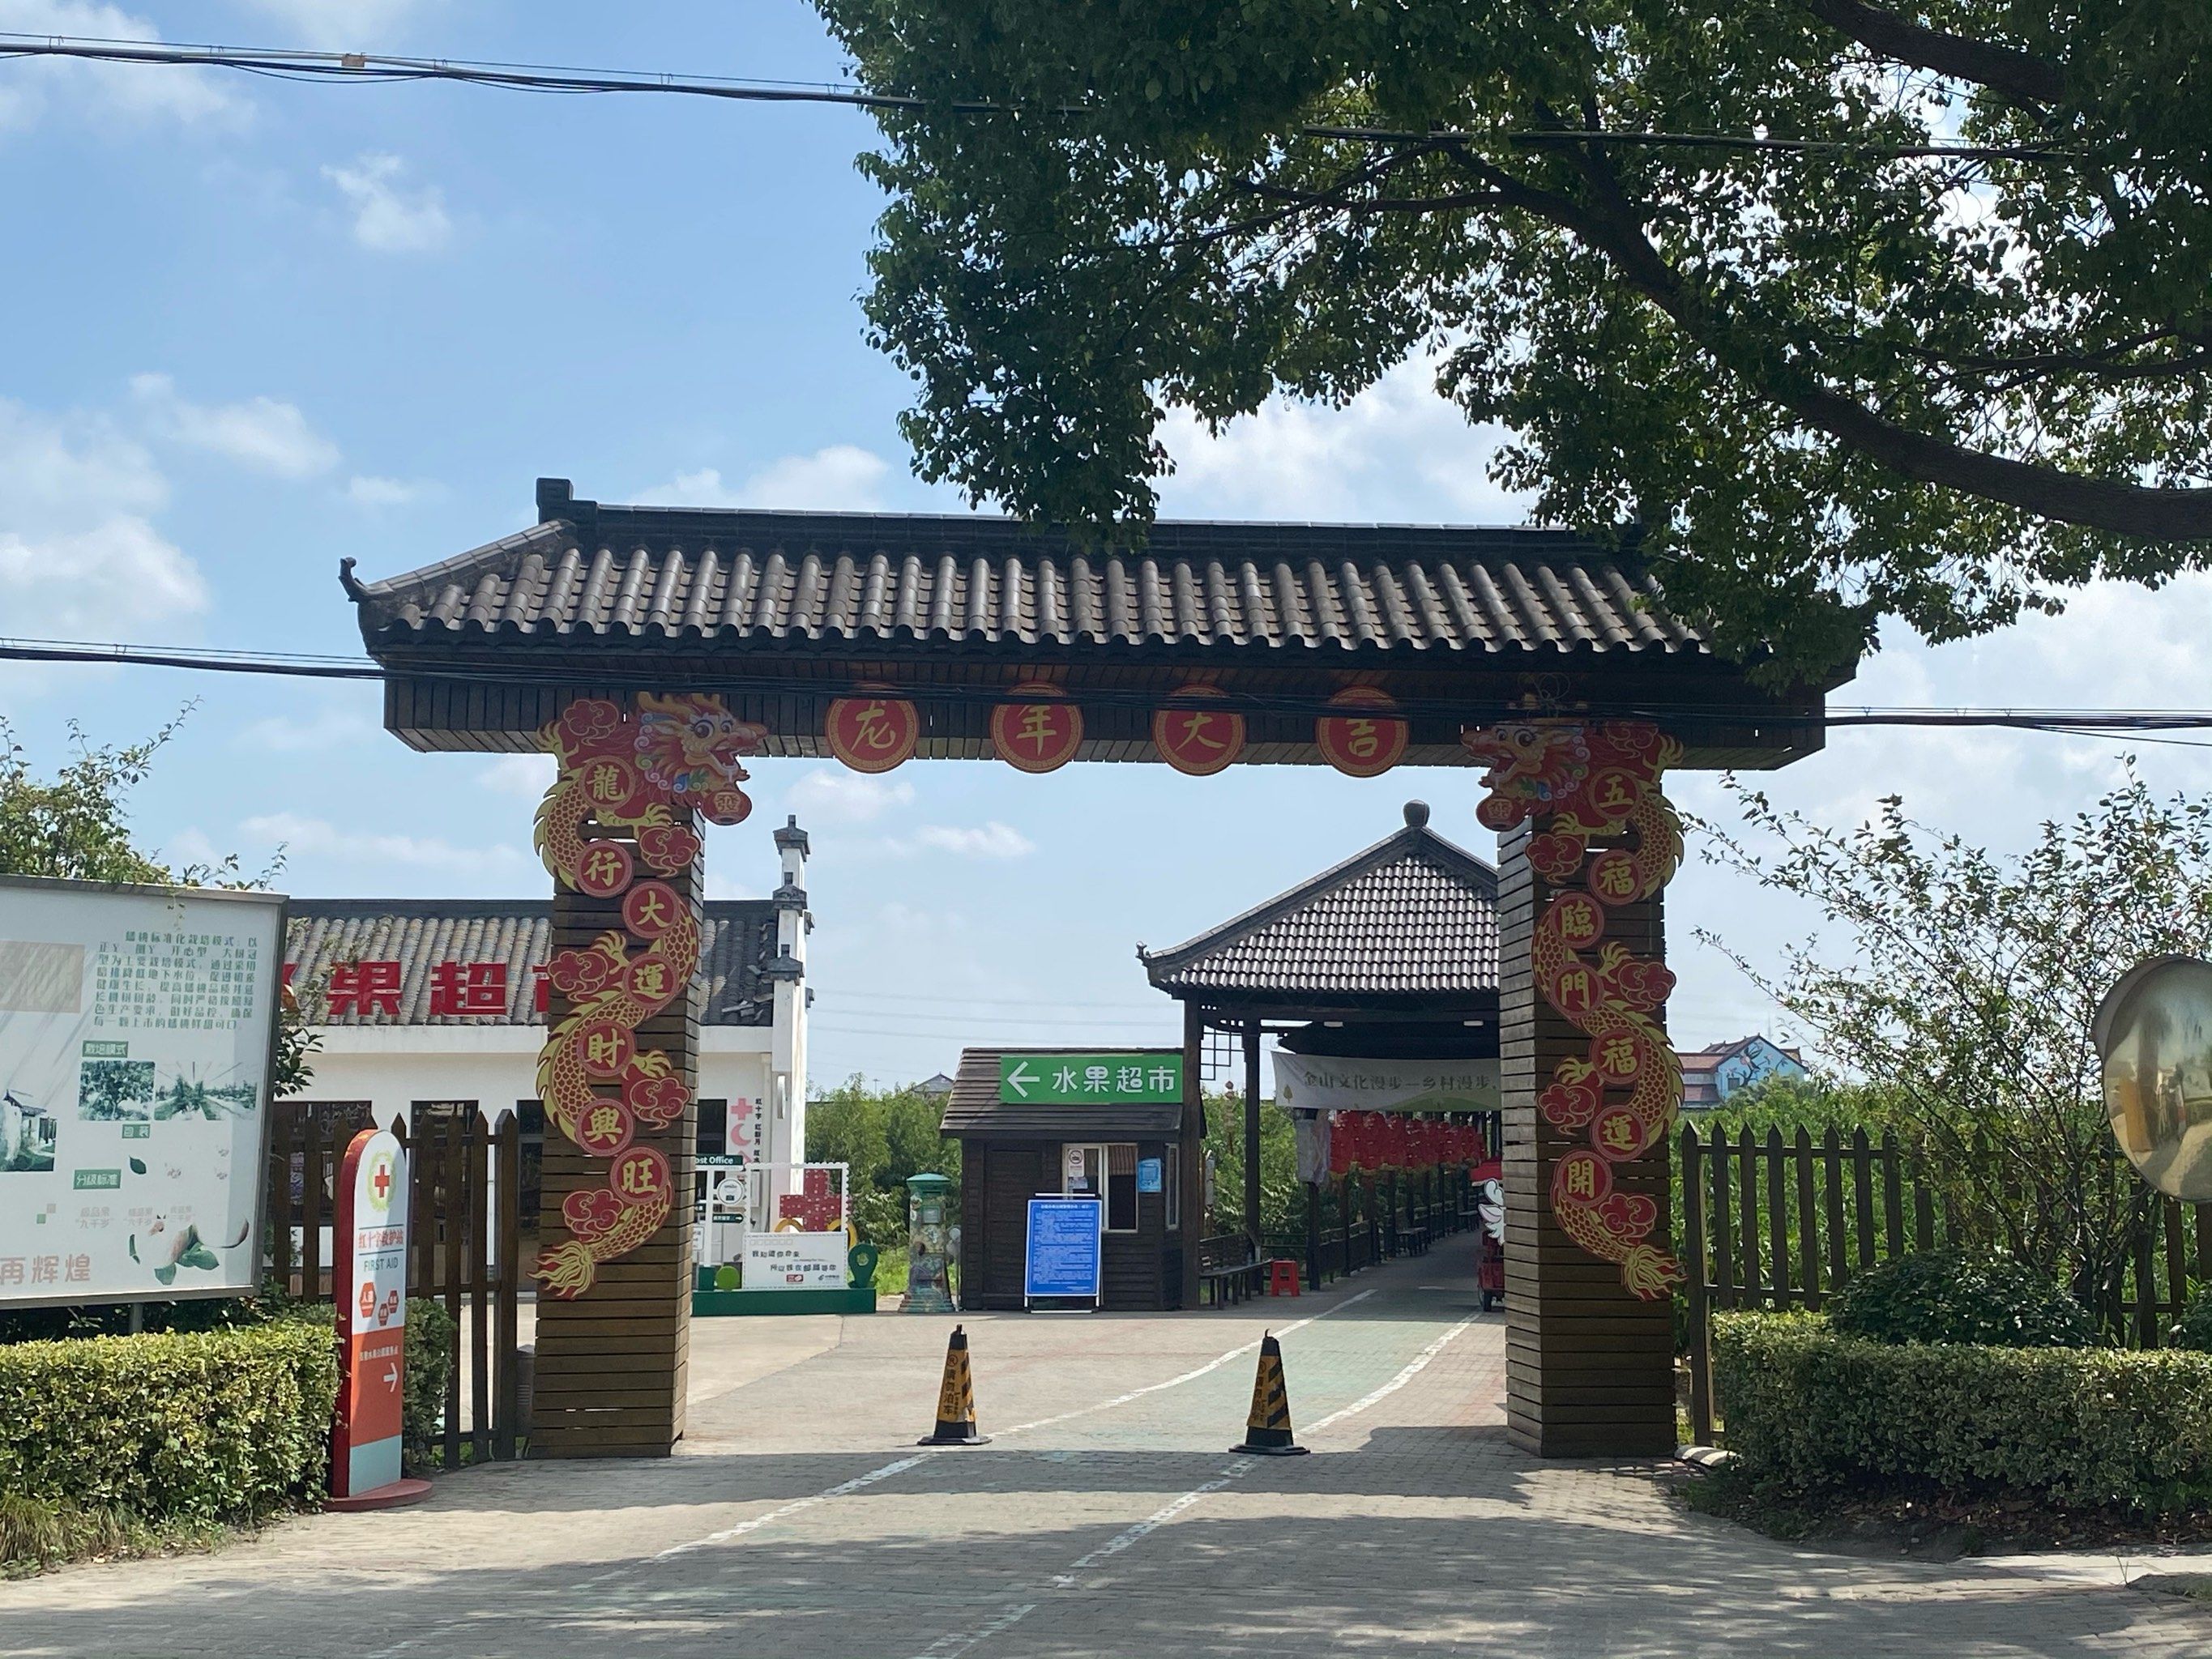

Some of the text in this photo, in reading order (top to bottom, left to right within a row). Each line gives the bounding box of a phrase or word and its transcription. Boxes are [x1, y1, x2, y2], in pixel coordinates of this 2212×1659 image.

[851, 700, 1377, 757] 龙年大吉
[282, 961, 550, 1016] 果超
[1052, 1065, 1176, 1094] 水果超市
[709, 1156, 734, 1164] Office
[358, 1228, 404, 1249] 红十字救护站
[0, 1254, 92, 1286] 再辉煌
[364, 1256, 399, 1272] FIRST AID
